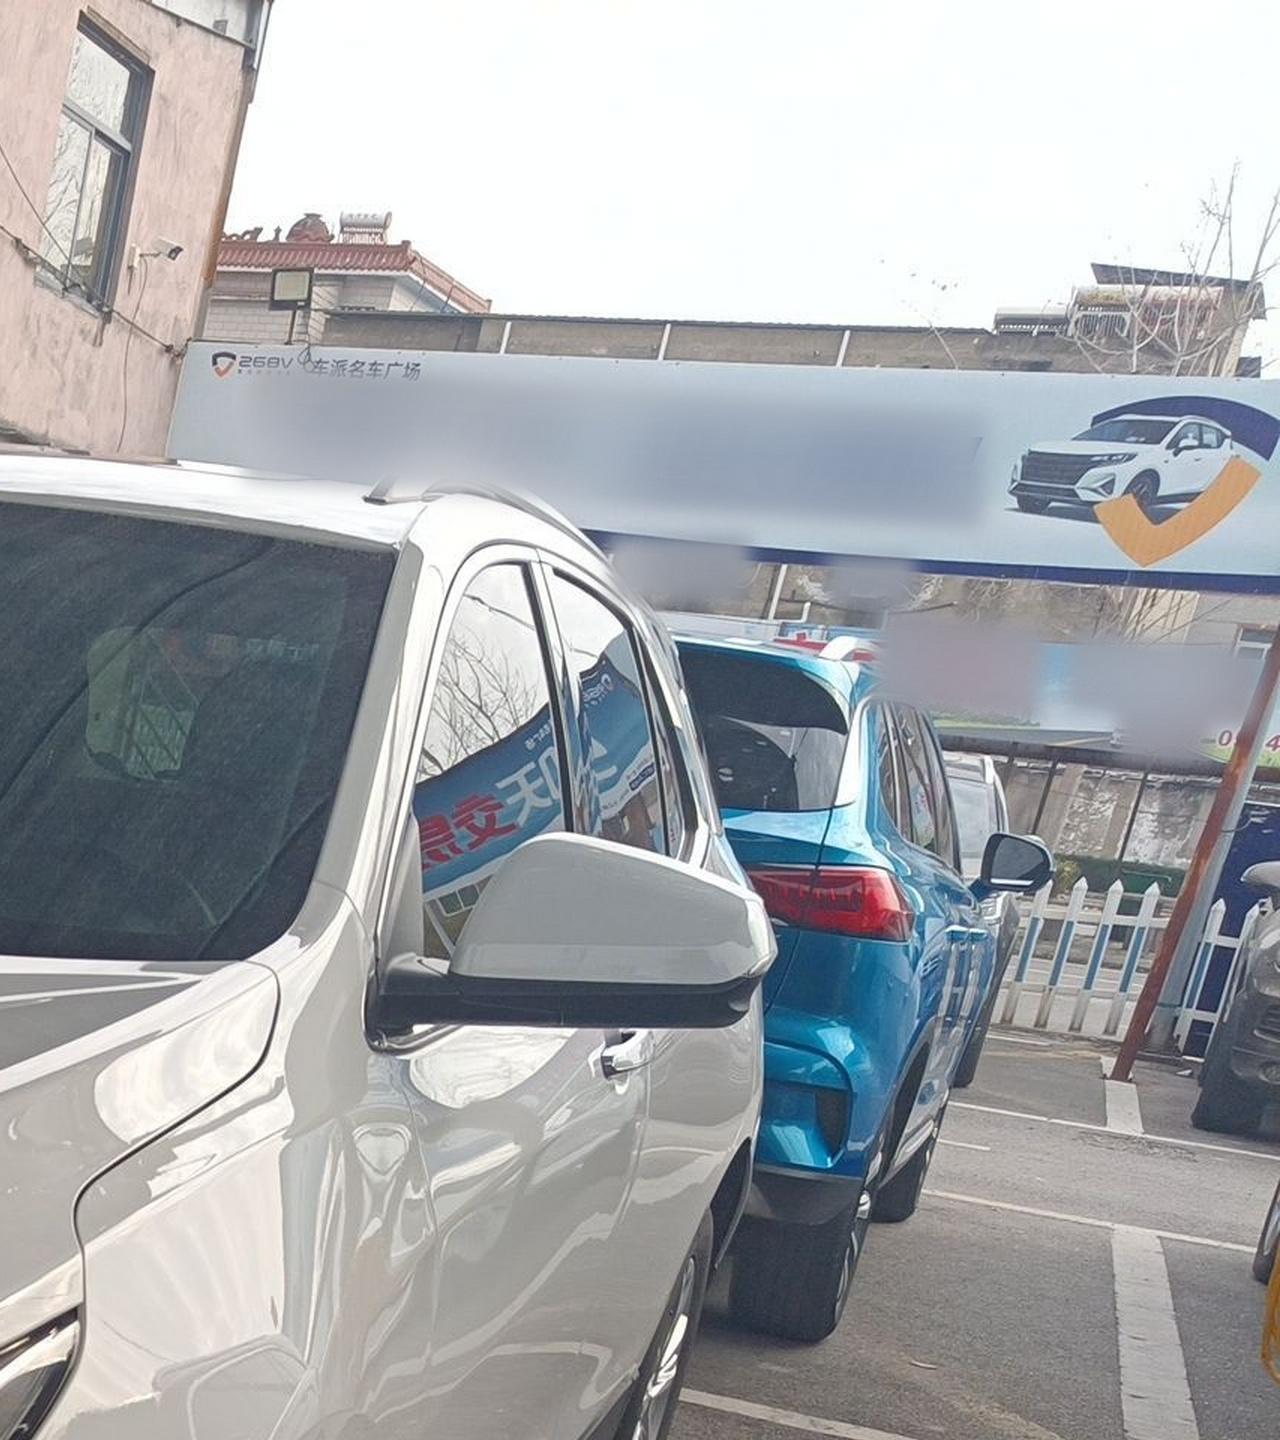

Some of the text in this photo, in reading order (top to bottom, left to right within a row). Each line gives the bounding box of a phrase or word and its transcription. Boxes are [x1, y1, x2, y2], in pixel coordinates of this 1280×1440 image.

[238, 355, 294, 370] 268V
[313, 358, 421, 382] 车派名车广场
